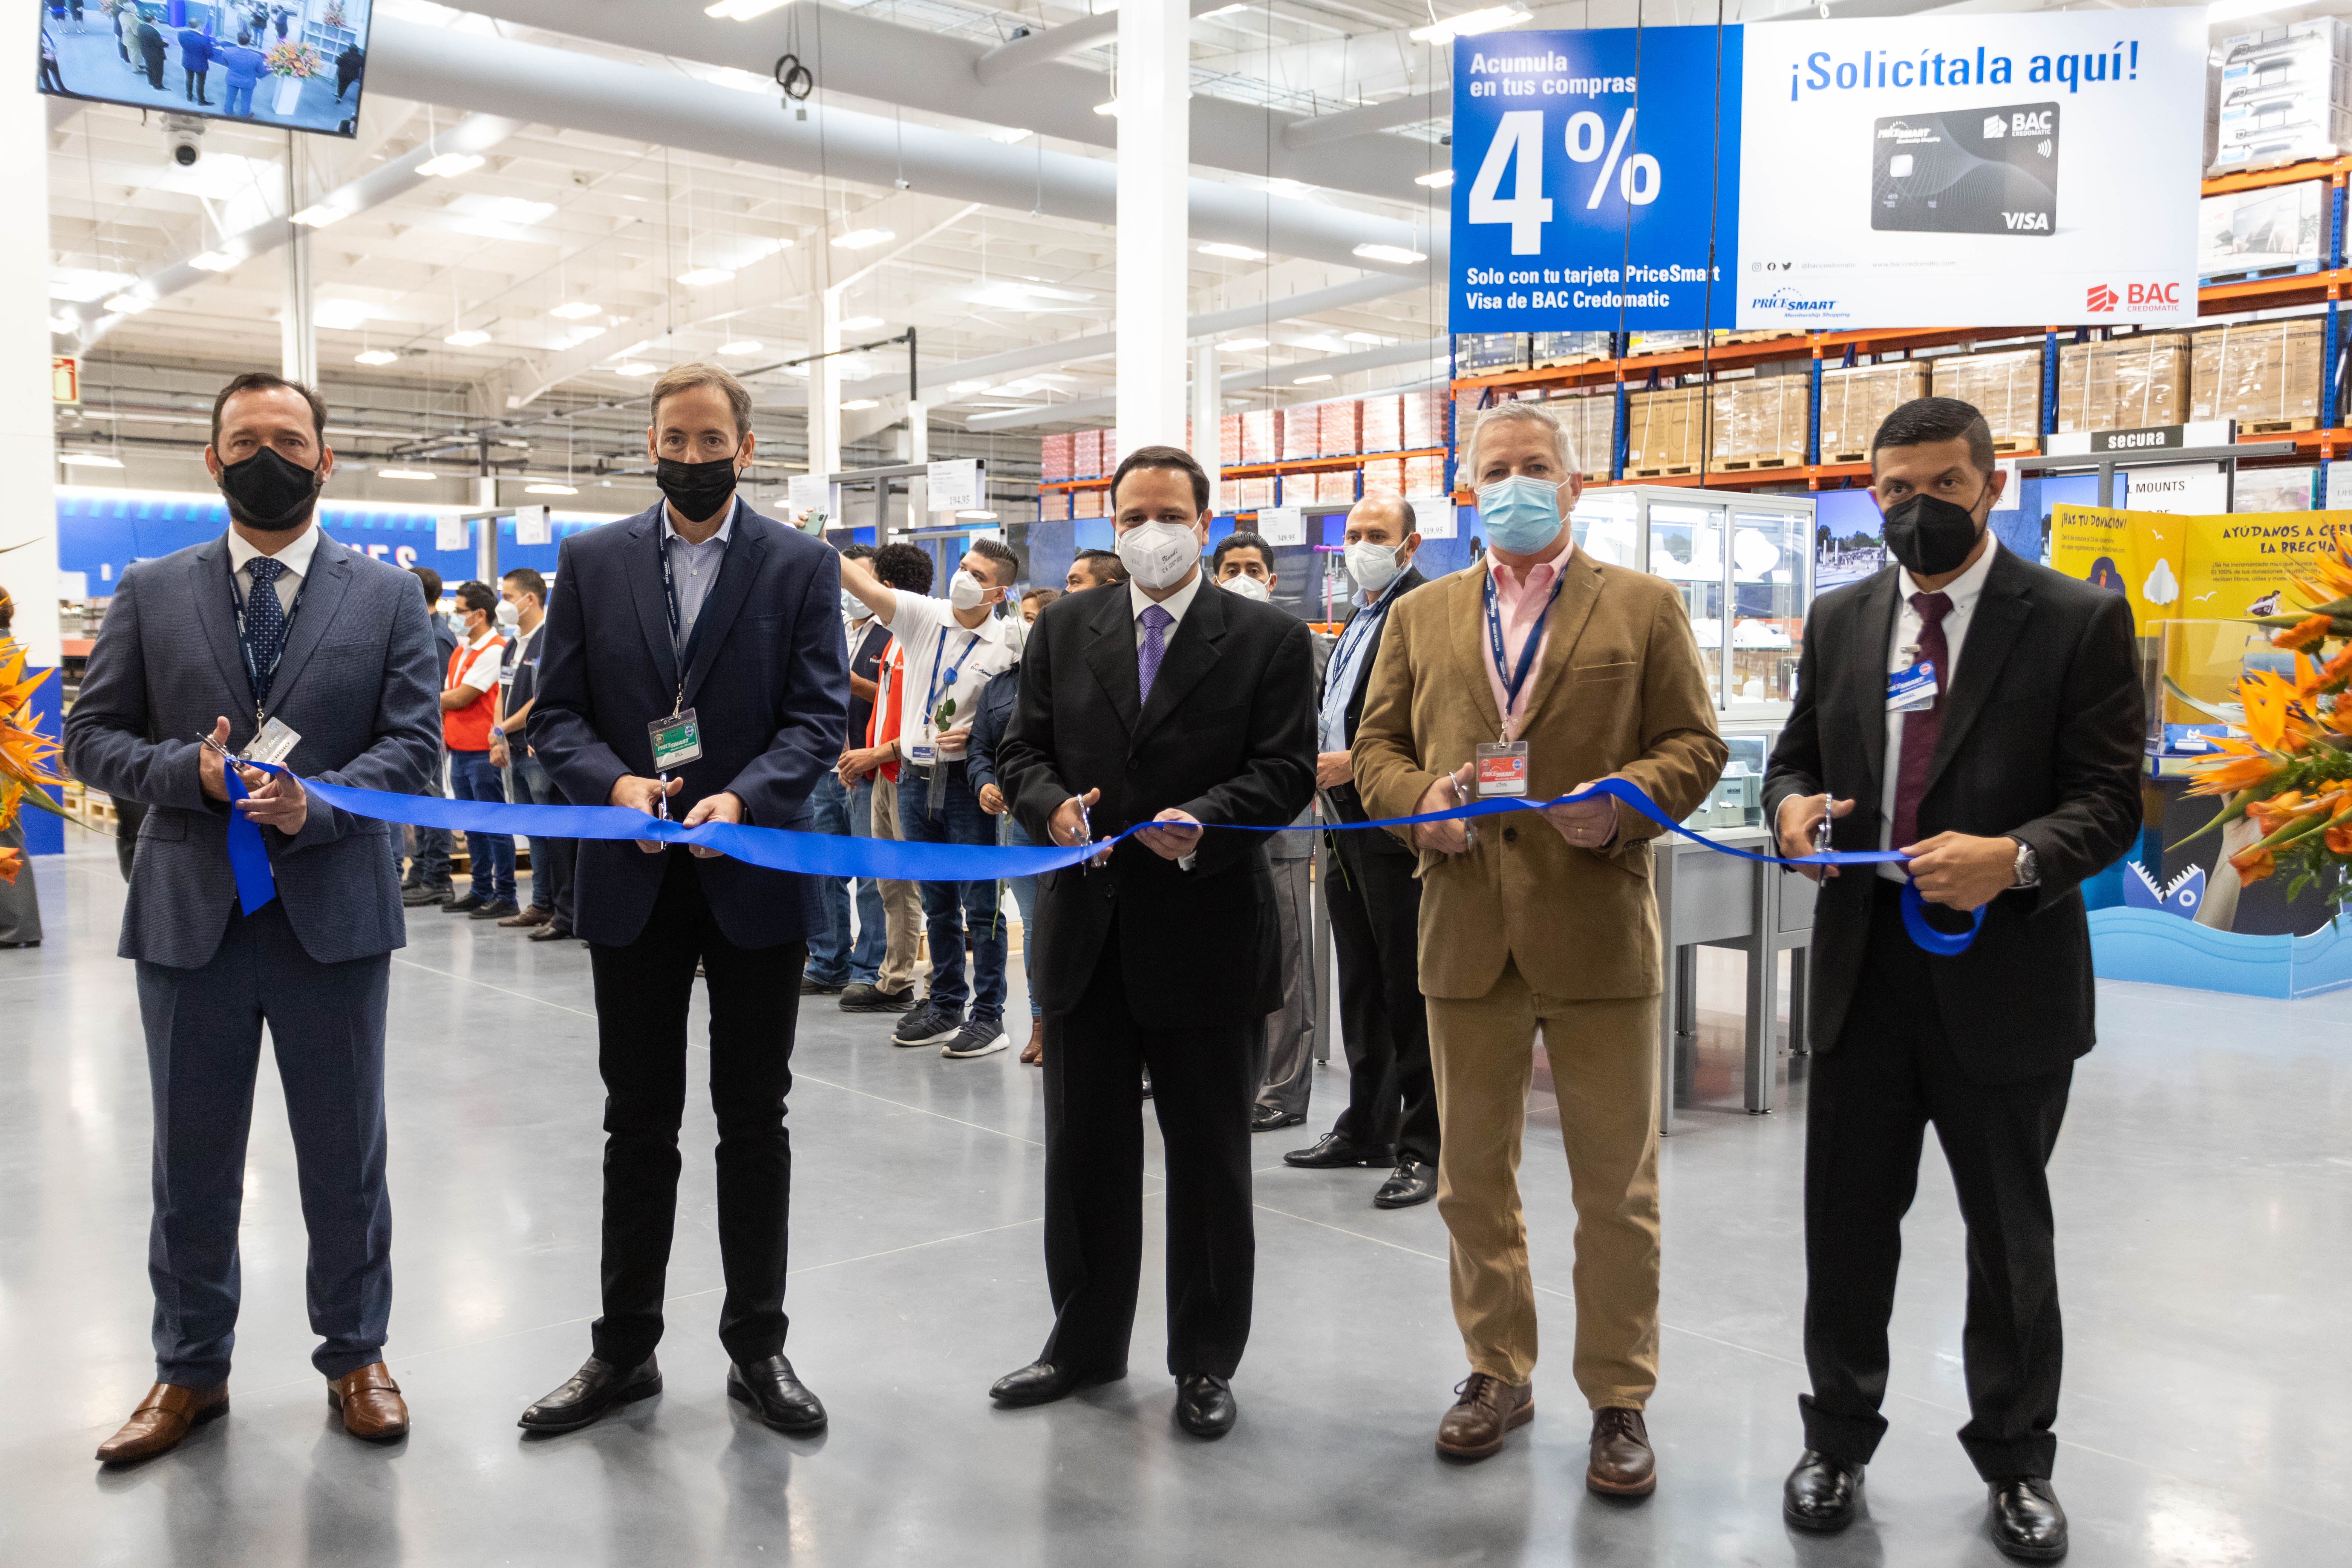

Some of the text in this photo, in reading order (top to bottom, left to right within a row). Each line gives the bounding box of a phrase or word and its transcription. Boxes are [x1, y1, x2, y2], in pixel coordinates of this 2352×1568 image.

[1470, 51, 1567, 74] Acumula
[1791, 40, 2139, 102] ¡Solicítala aquí!
[1470, 76, 1637, 99] en tus compras
[2012, 110, 2052, 131] BAC
[2001, 212, 2049, 230] VISA
[1466, 264, 1720, 287] Solo con tu tarjeta PriceSmat
[1466, 289, 1670, 309] Visa de BAC Credomatic
[2127, 282, 2180, 305] BAC
[1751, 298, 1837, 311] PRICESMART
[2136, 481, 2185, 494] MOUNTS
[2061, 512, 2127, 531] ¡HAZ TU DONACIÓN!
[2223, 525, 2300, 539] AYÚDANOS
[2305, 526, 2314, 537] A
[2260, 540, 2336, 554] LA BRECHA
[657, 738, 690, 752] PRICESMART
